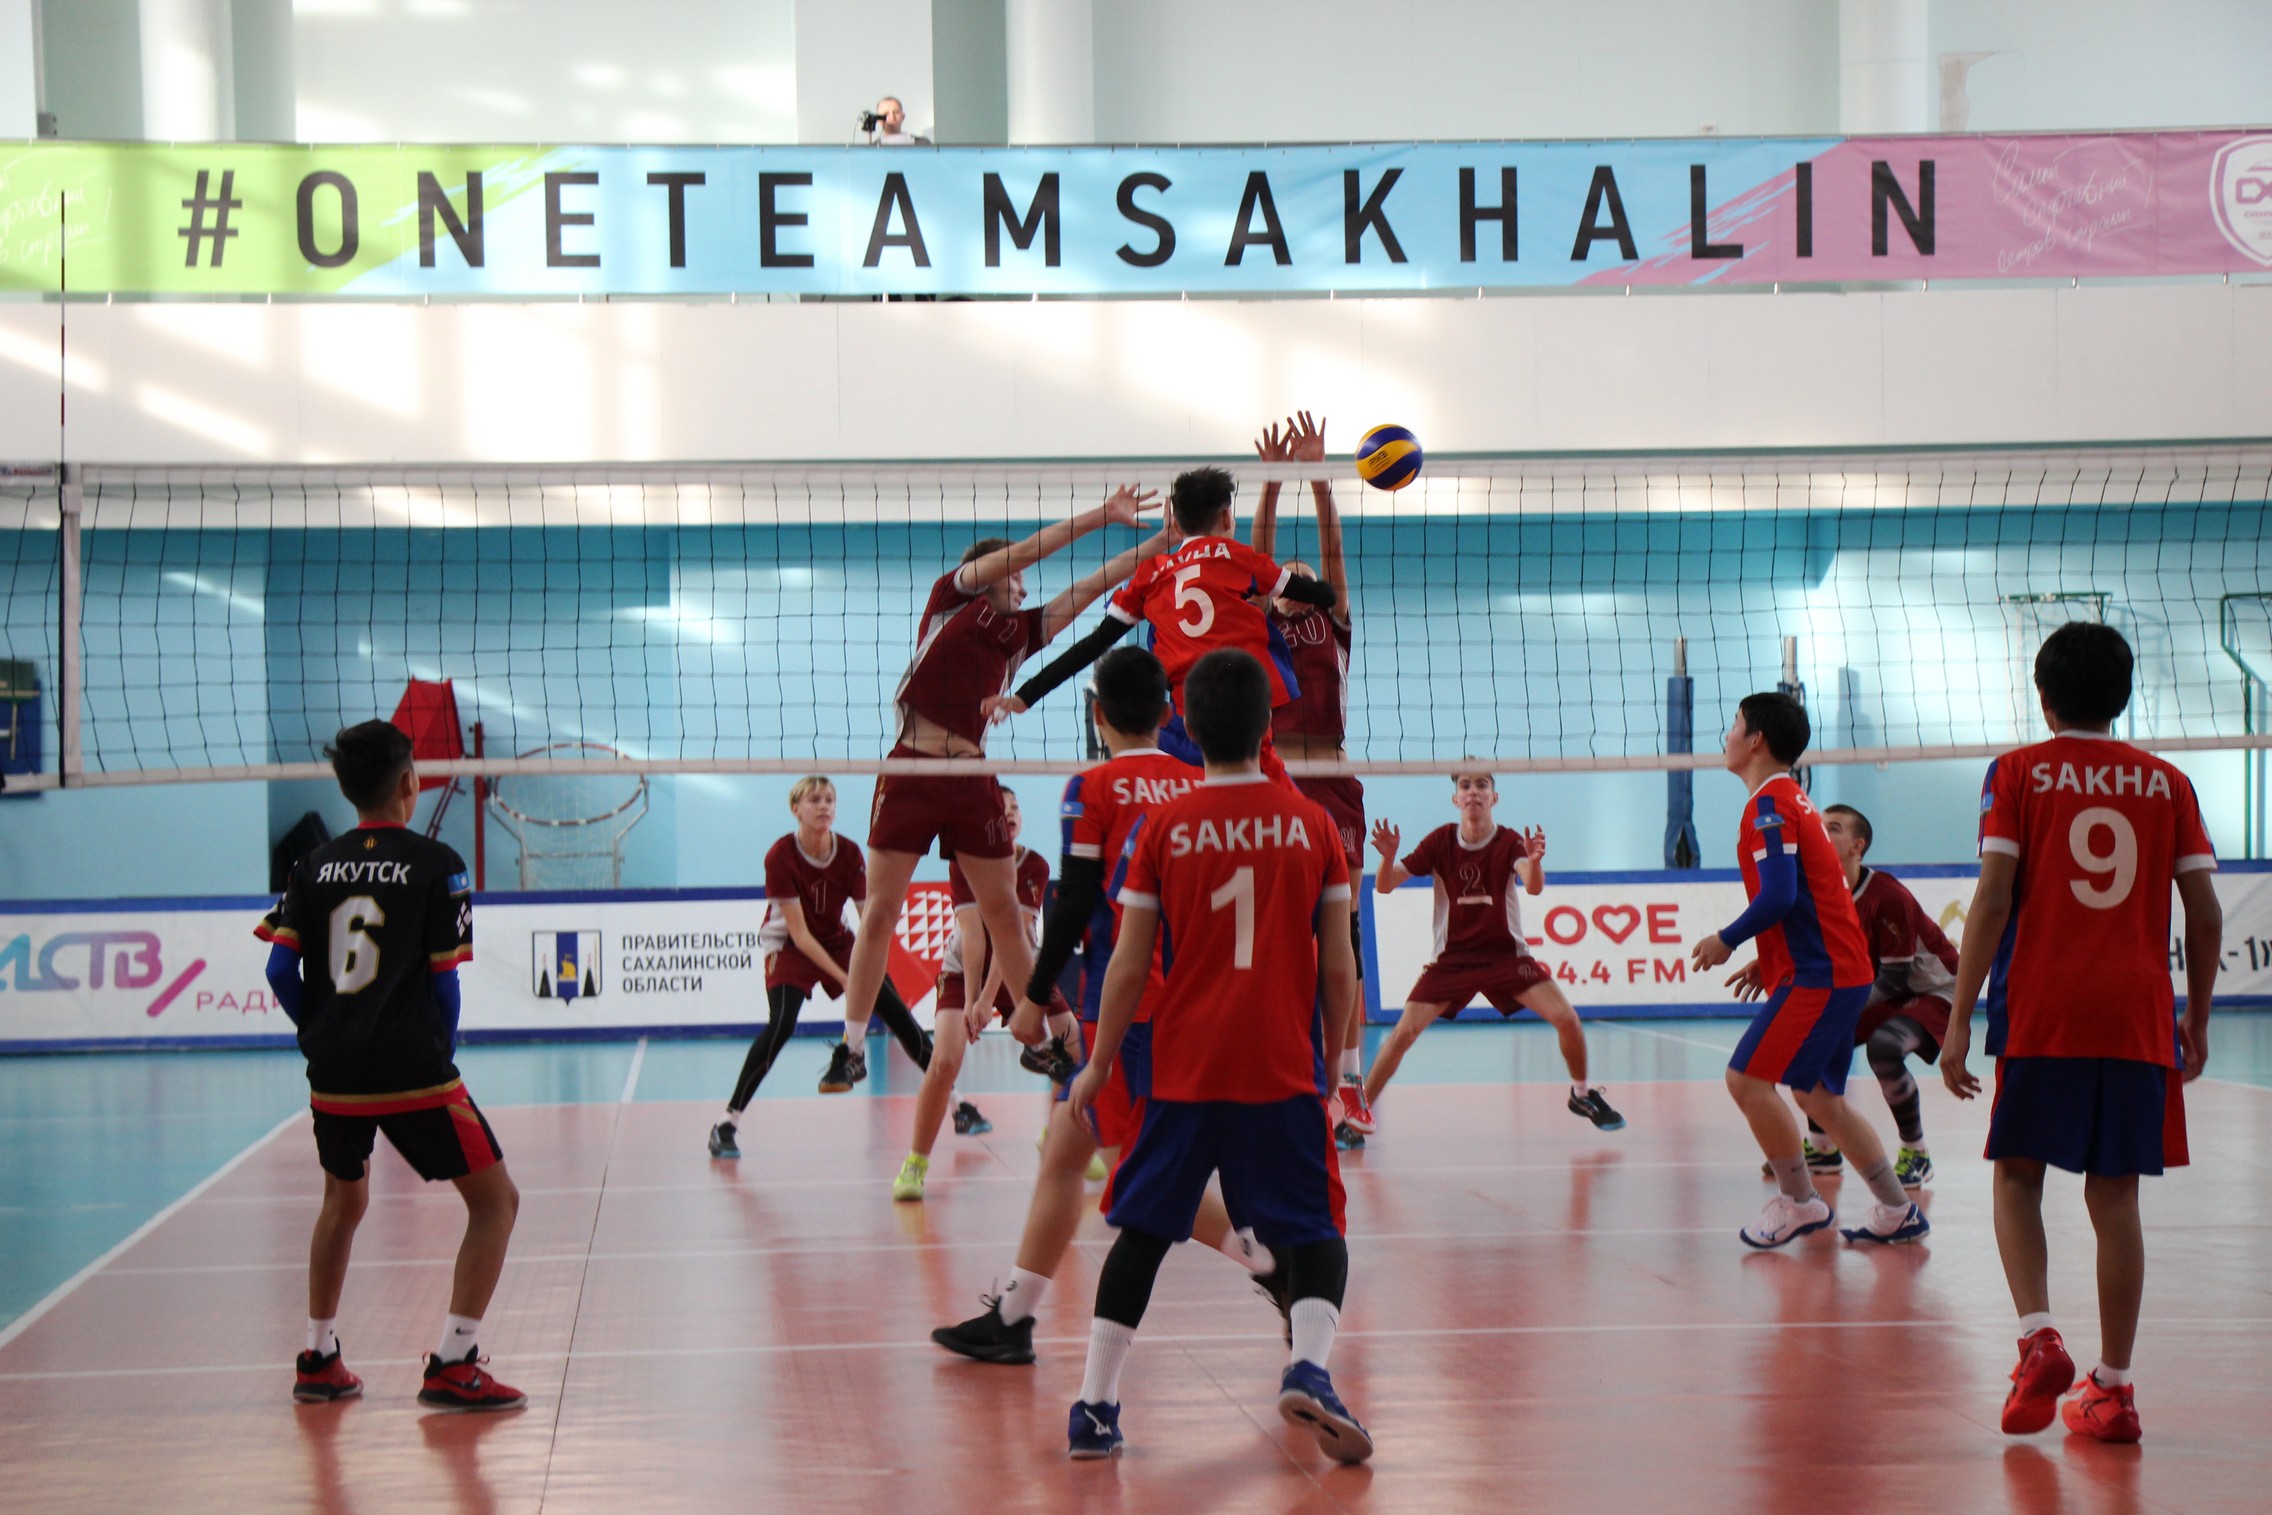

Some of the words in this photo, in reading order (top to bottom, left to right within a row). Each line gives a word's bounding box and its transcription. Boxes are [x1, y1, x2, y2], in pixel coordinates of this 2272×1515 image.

[178, 159, 1936, 269] #ONETEAMSAKHALIN
[1174, 563, 1215, 638] 5
[1112, 776, 1205, 805] SAKH
[2031, 761, 2171, 800] SAKHA
[1170, 814, 1311, 857] SAKHA
[316, 861, 411, 885] ЯКУТСК
[2069, 806, 2138, 910] 9
[811, 879, 827, 914] 1
[1459, 863, 1485, 898] 2
[1211, 866, 1255, 969] 1
[329, 895, 385, 994] 6
[622, 932, 762, 951] ПРАВИТЕЛЬСТВ
[622, 947, 752, 972] САХАЛИНСКОЙ
[1627, 958, 1686, 984] FM
[622, 976, 703, 994] ОБЛАСТИ
